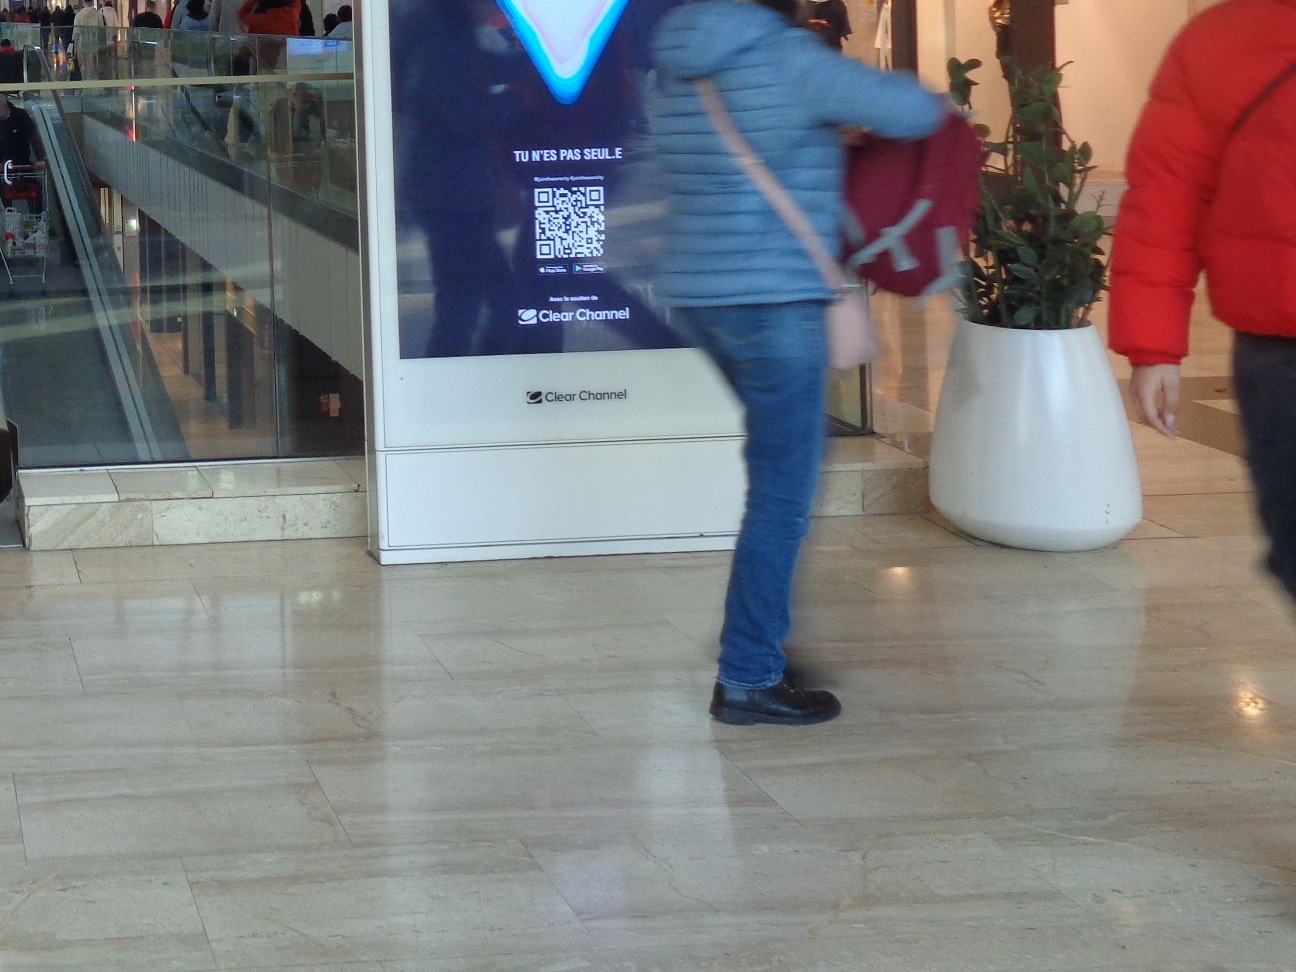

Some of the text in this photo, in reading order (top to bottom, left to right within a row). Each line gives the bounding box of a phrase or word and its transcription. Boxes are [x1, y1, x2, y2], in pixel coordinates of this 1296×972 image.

[513, 148, 623, 162] TU N'ES PAS SEUL.E
[539, 307, 630, 322] Clear Channel
[545, 389, 627, 403] Clear Channel
